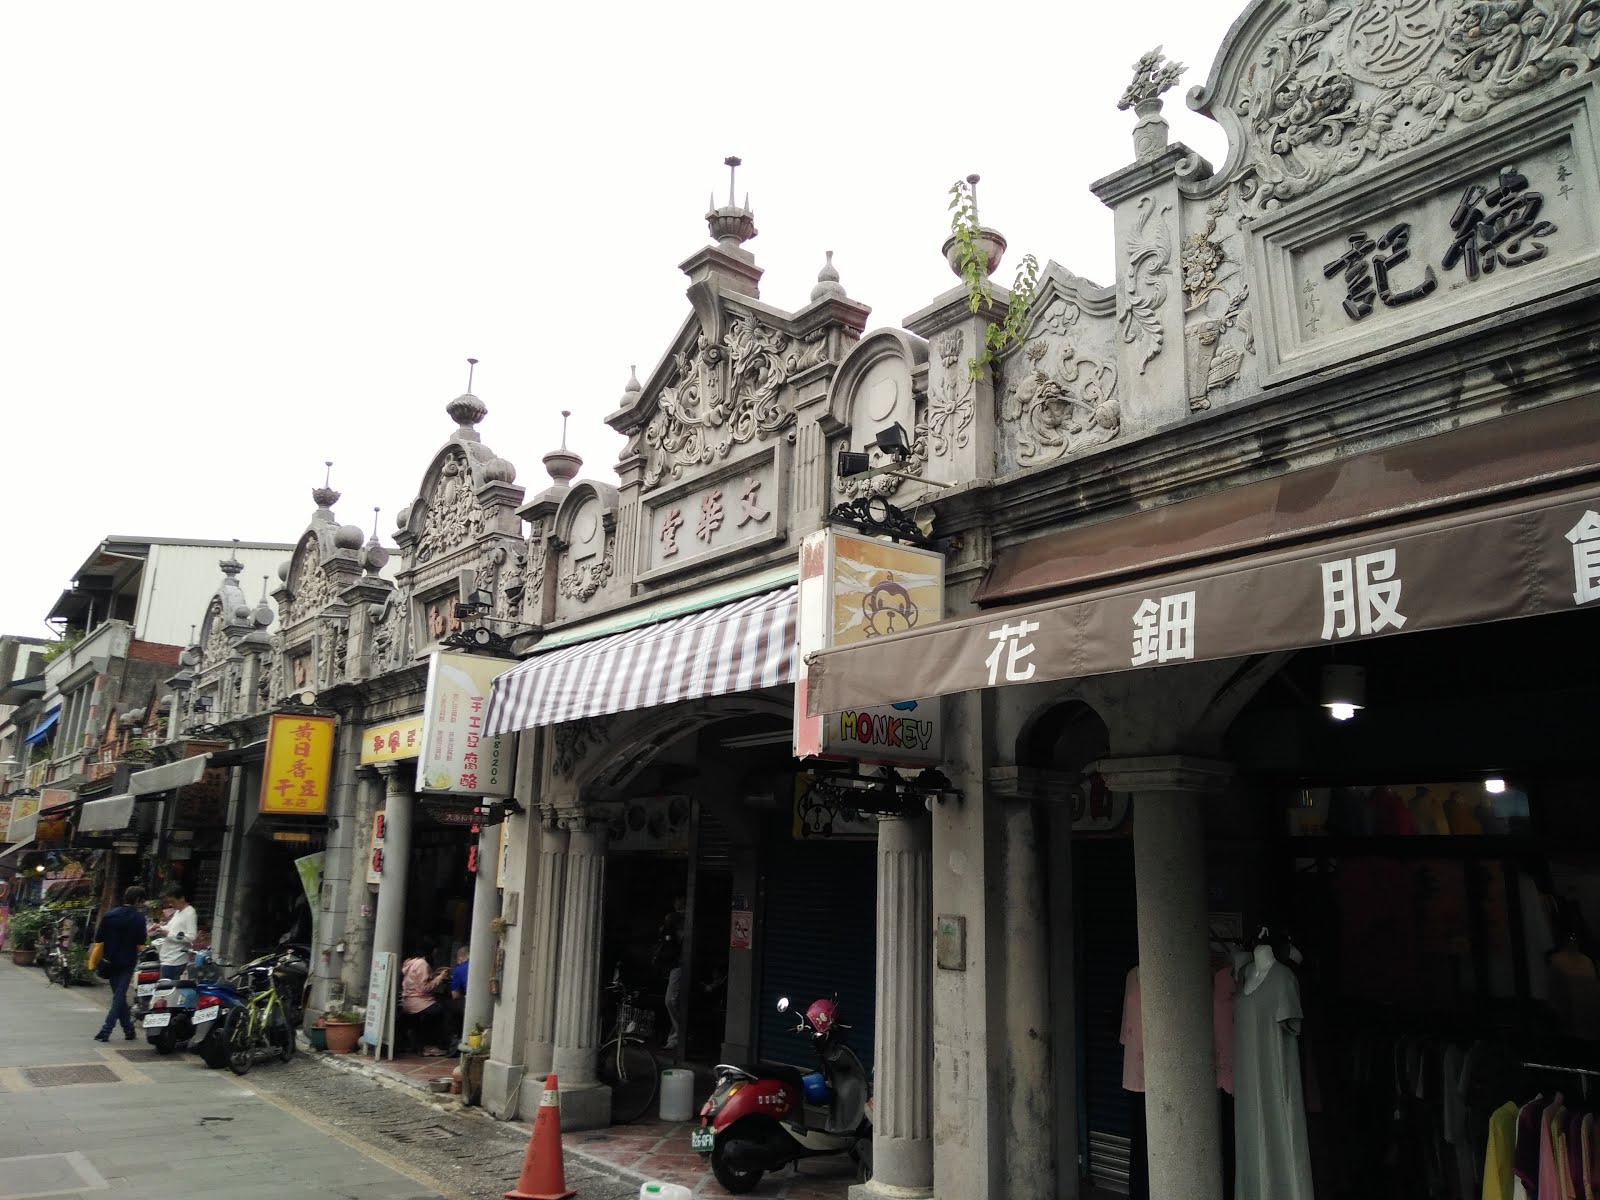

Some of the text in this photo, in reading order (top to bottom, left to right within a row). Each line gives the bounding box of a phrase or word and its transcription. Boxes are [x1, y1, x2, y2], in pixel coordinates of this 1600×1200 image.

[460, 696, 484, 790] 手工豆腐酪
[841, 710, 933, 750] MONKEY
